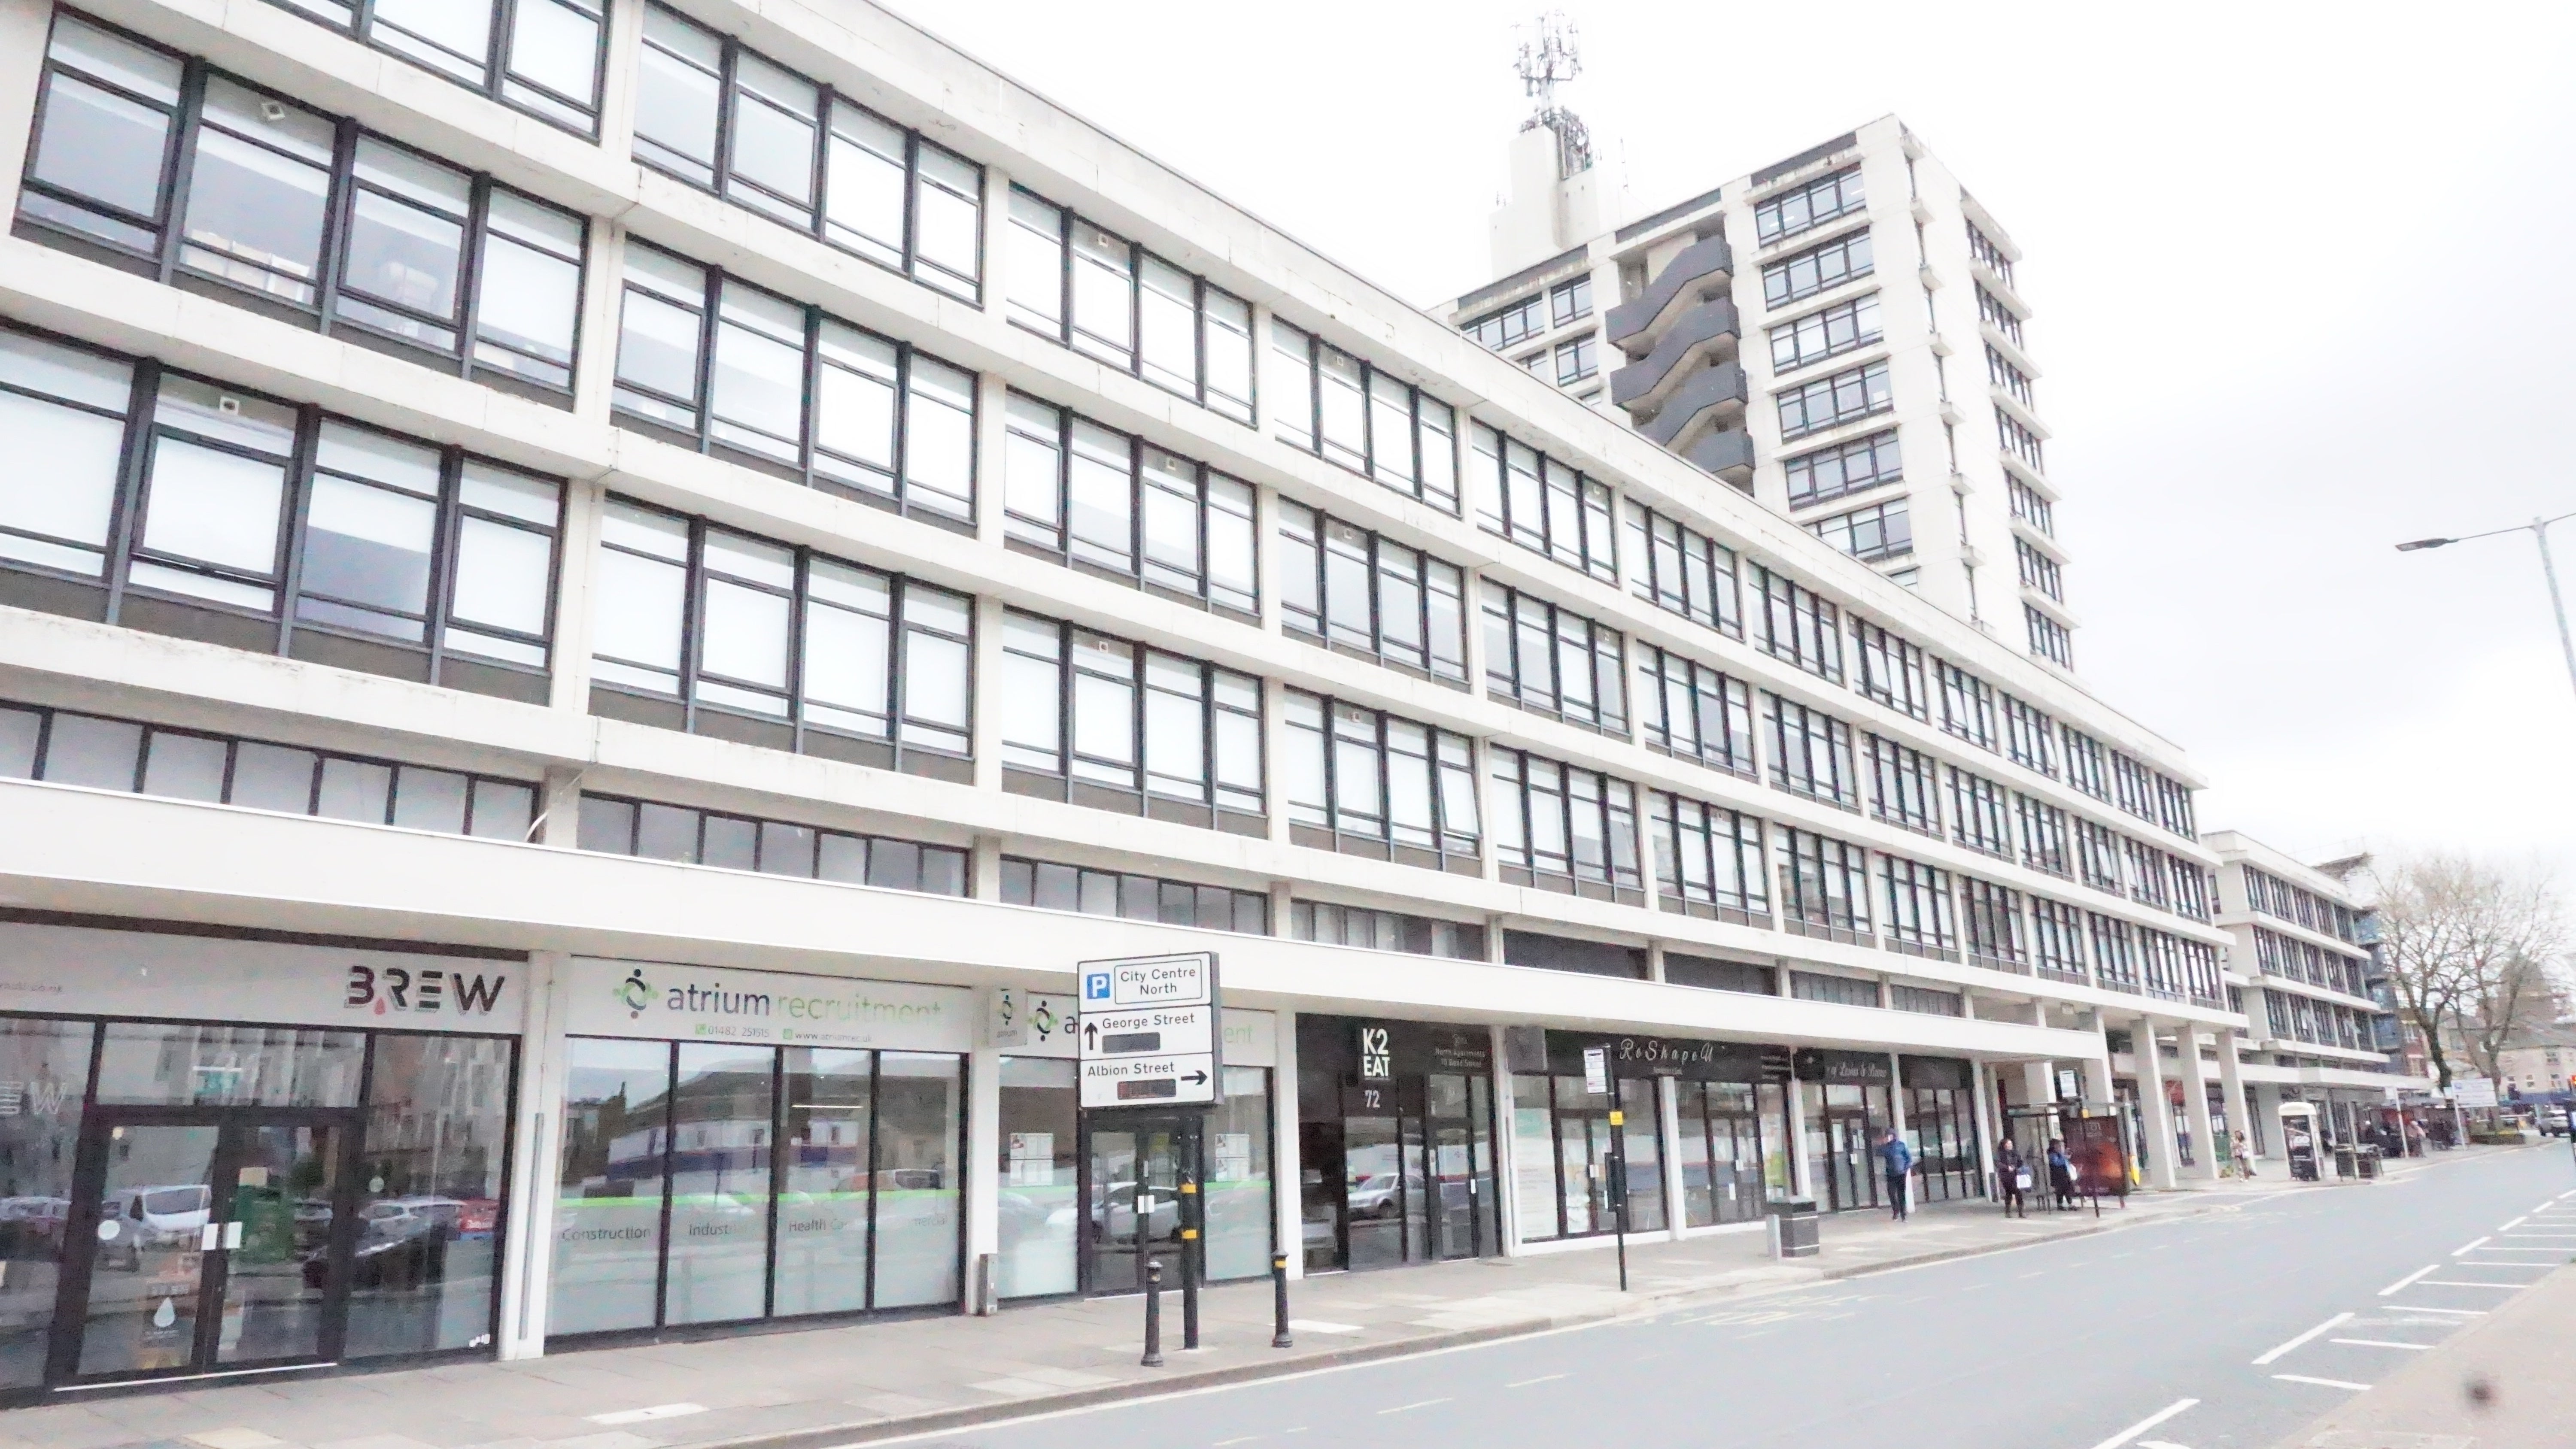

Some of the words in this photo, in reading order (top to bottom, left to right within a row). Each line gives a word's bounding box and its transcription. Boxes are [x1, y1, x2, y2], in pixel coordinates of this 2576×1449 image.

[1120, 971, 1146, 982] City
[1151, 967, 1196, 979] Centre
[344, 965, 505, 1016] BREW
[1092, 976, 1107, 997] P
[1139, 982, 1177, 995] North
[667, 982, 770, 1016] atrium
[778, 992, 941, 1024] recruitment
[1103, 1018, 1148, 1029] George
[1154, 1012, 1195, 1025] Street
[708, 1025, 736, 1037] 01482
[1363, 1028, 1389, 1055] K2
[1087, 1065, 1128, 1077] Albion
[1133, 1061, 1175, 1074] Street
[1363, 1055, 1390, 1077] EAT
[1364, 1089, 1380, 1109] 72
[562, 1226, 651, 1241] Construction
[789, 1219, 826, 1232] Health
